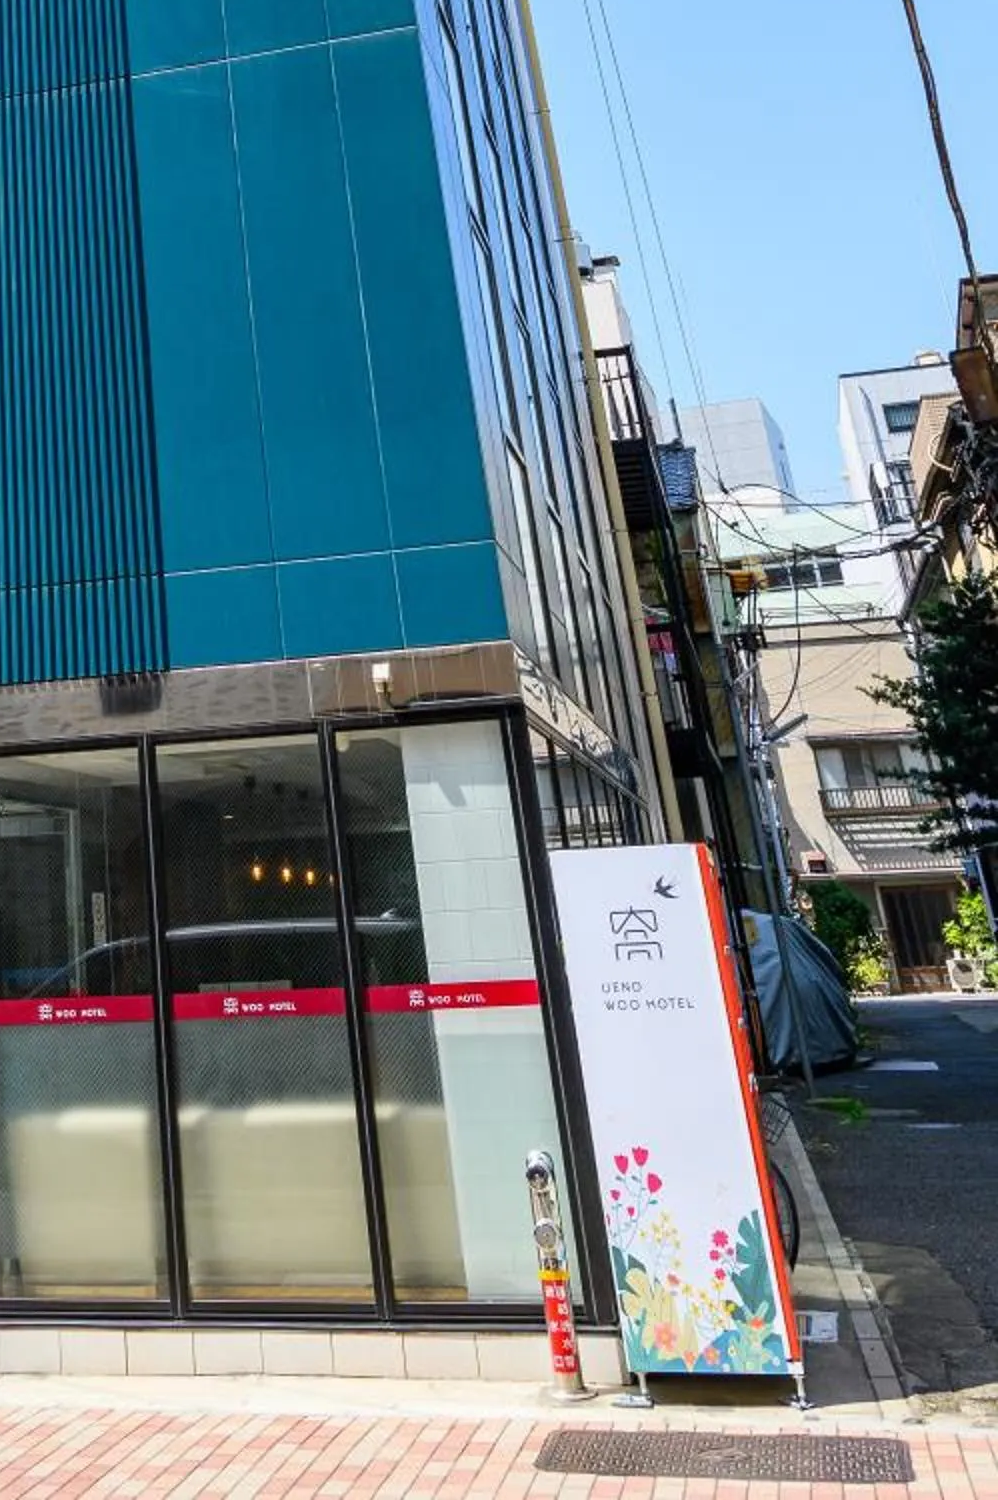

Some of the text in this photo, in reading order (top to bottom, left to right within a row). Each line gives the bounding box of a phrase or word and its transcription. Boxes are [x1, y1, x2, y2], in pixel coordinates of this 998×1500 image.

[602, 981, 643, 993] UENO
[604, 997, 695, 1011] WOO HOTEL
